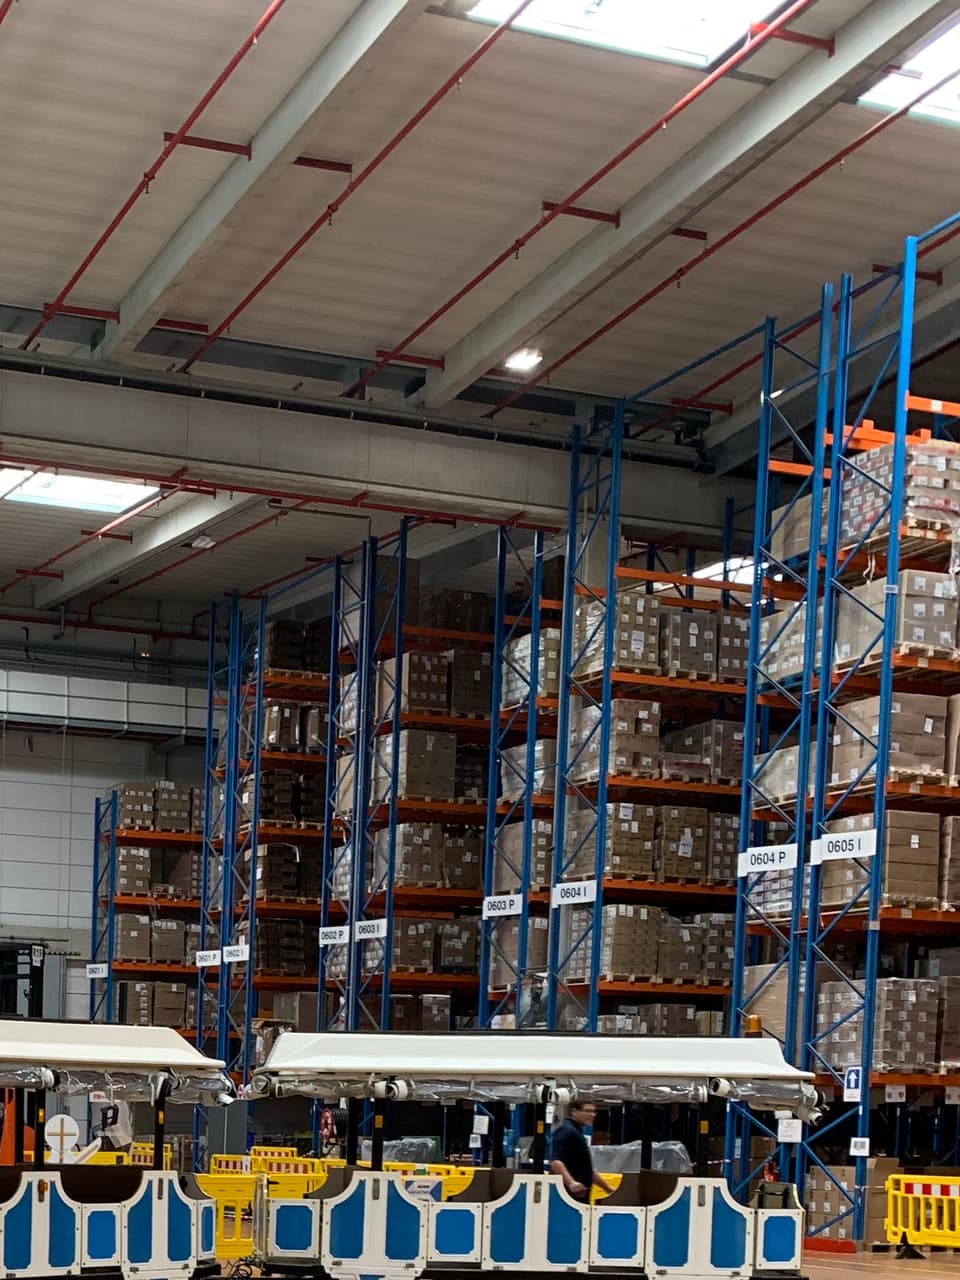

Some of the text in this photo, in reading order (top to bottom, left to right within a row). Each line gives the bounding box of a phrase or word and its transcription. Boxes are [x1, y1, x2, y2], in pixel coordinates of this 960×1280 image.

[827, 839, 854, 853] 0605
[750, 851, 786, 866] 0604 P
[560, 887, 581, 899] 0604
[487, 899, 515, 911] 0603 P
[321, 930, 344, 940] 0602 P
[358, 924, 375, 935] 0603
